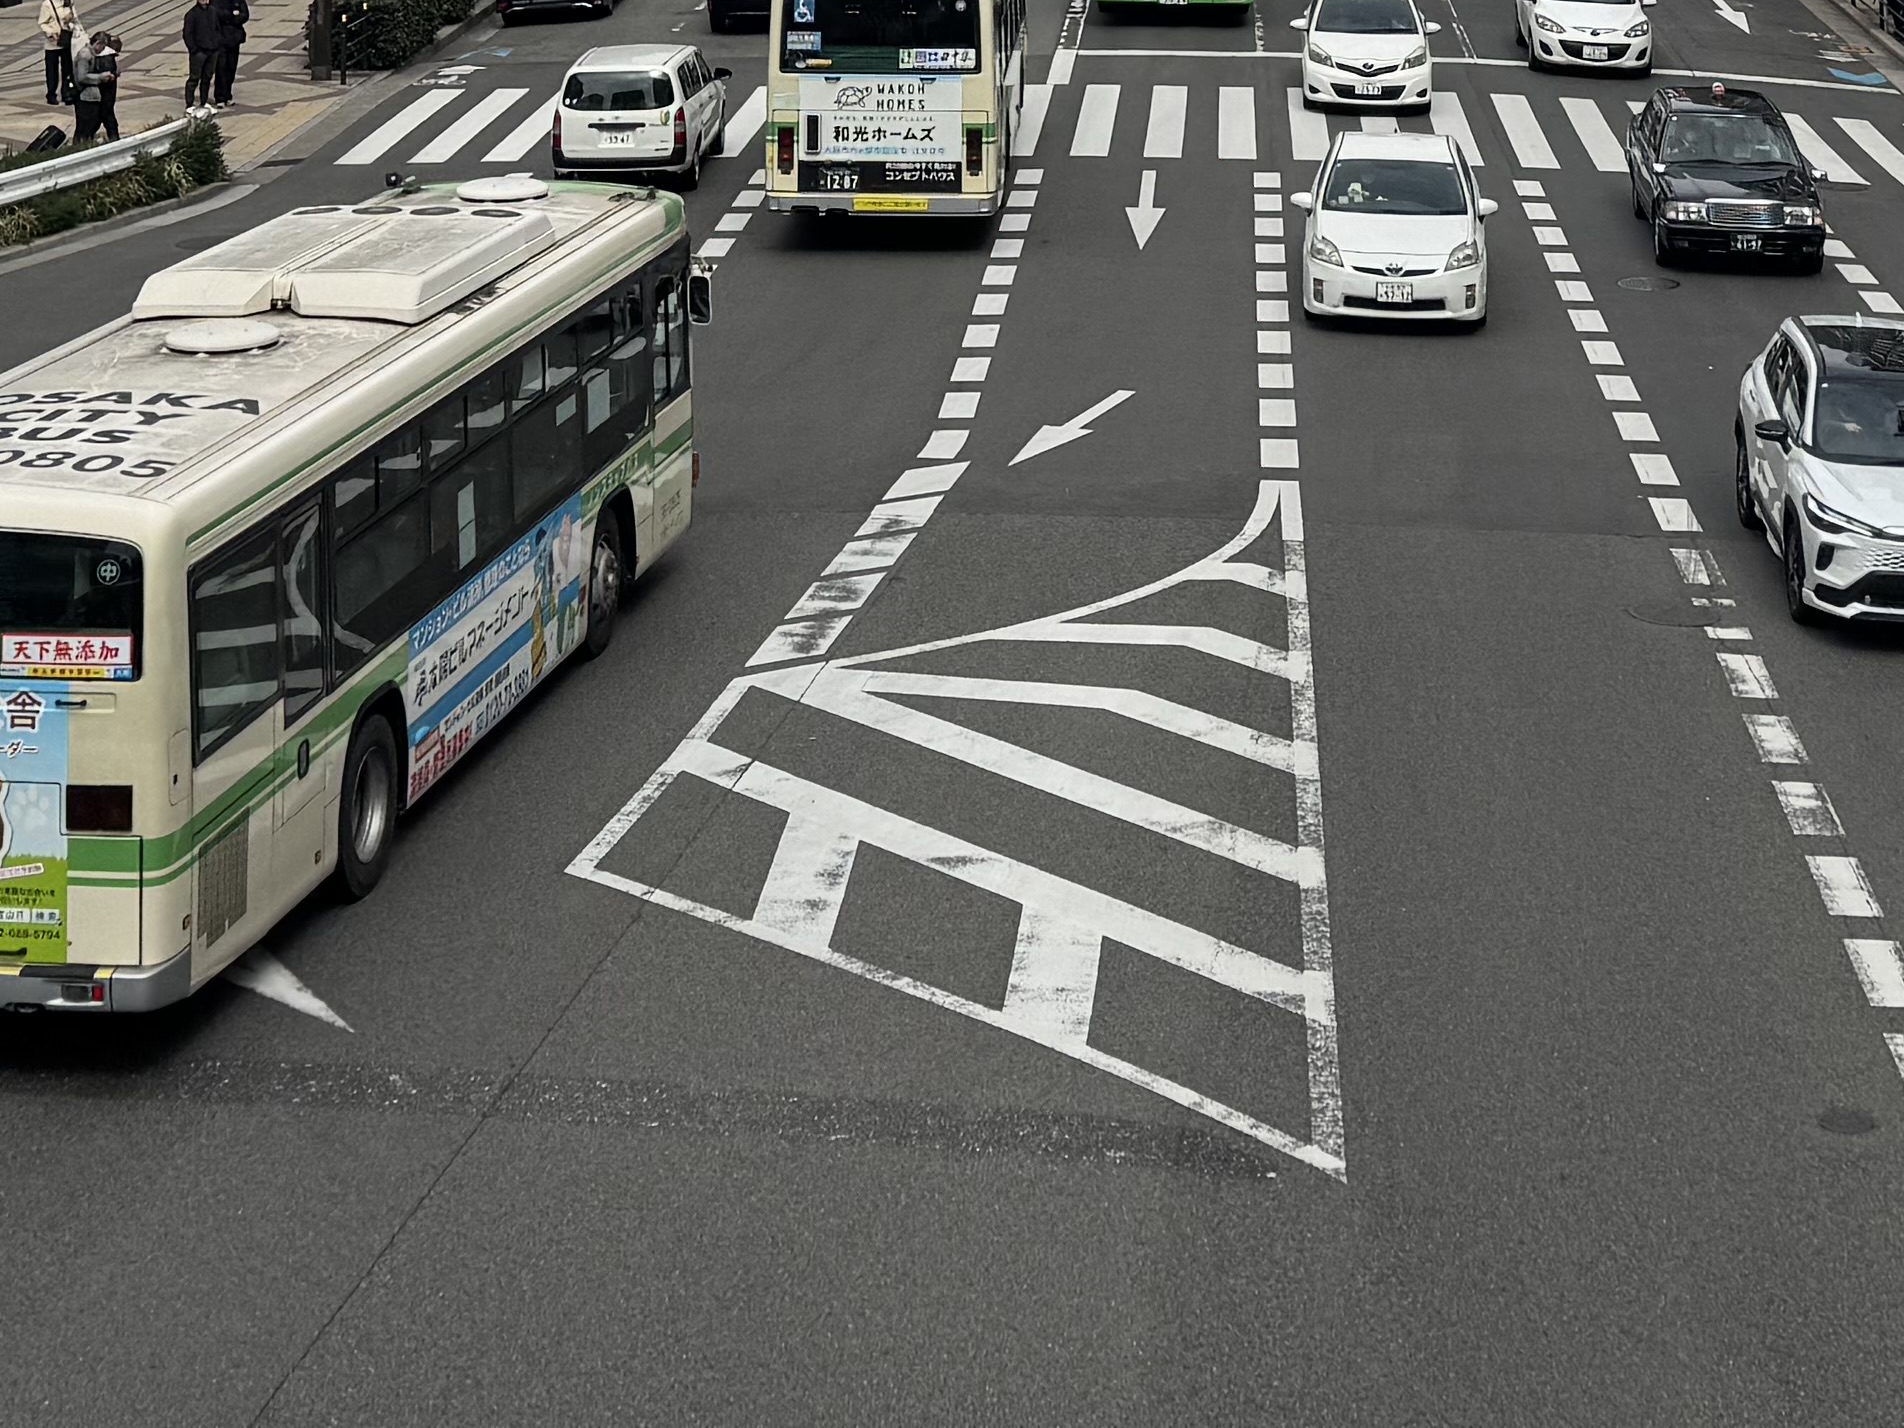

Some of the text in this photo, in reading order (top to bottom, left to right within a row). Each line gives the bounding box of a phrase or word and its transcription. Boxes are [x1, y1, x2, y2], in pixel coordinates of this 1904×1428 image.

[876, 83, 926, 95] WAKOH
[876, 98, 926, 111] HOMES
[832, 125, 937, 143] 和光ホームズ
[12, 639, 120, 662] 天下無添加
